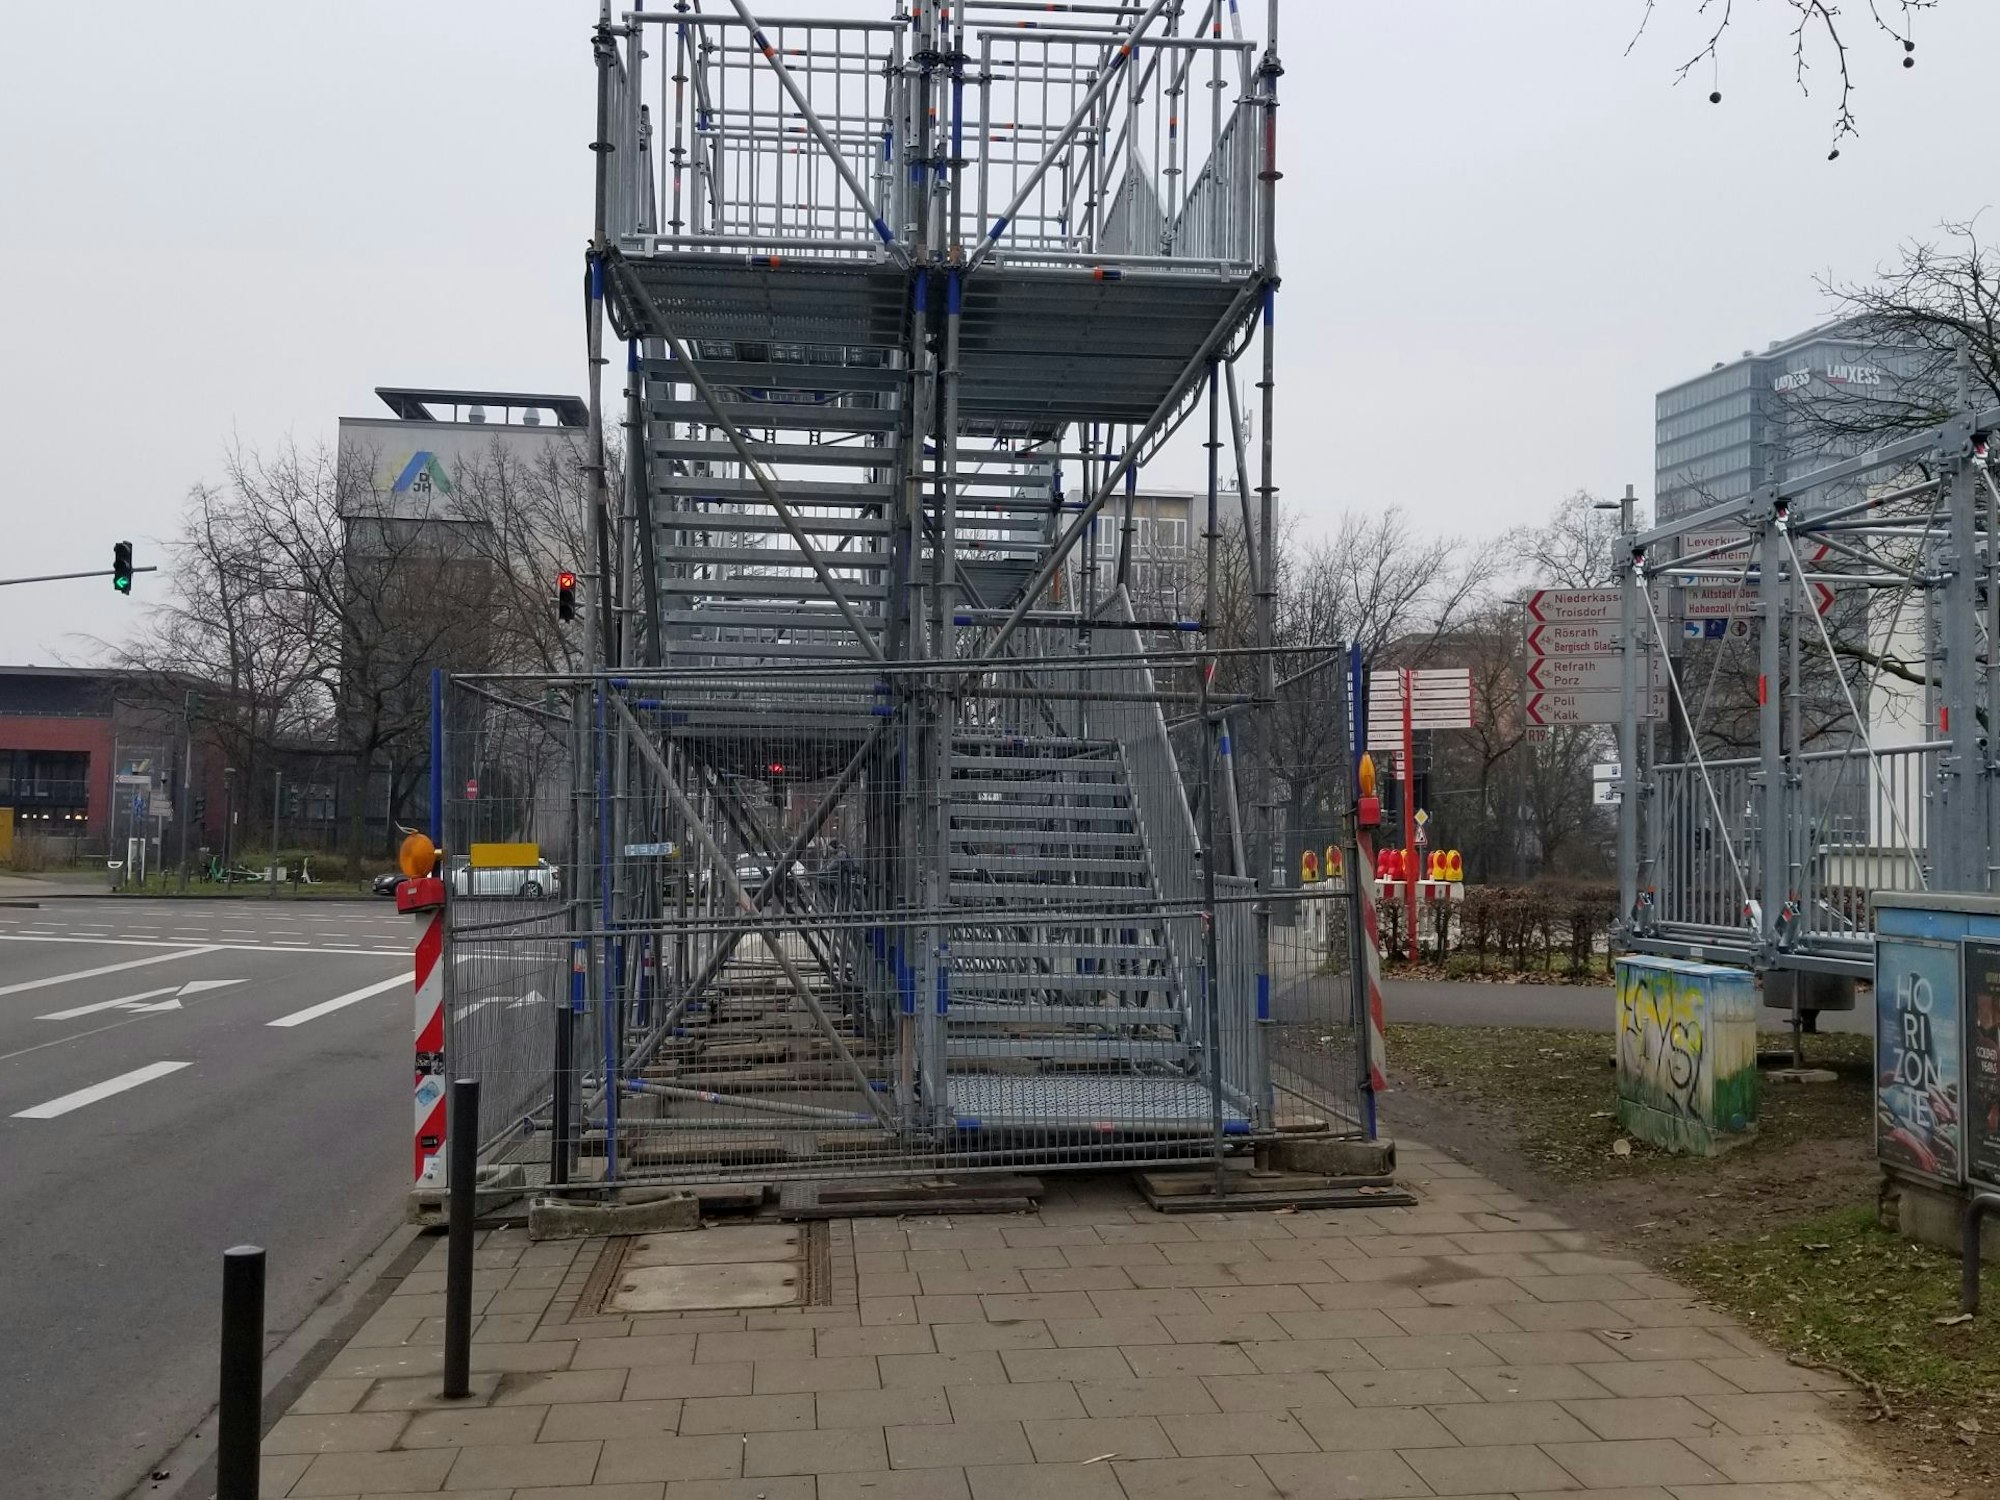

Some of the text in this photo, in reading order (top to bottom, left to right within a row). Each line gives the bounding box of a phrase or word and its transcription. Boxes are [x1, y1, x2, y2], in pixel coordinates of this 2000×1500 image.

[1827, 364, 1881, 385] LANXESS
[1554, 592, 1622, 604] Niederkass
[1556, 606, 1607, 617] Troisdorf
[1554, 627, 1598, 638] Rösrath
[1554, 642, 1590, 653] Bergisch
[1554, 661, 1596, 672] Refrath
[1554, 675, 1580, 686] Porz
[1553, 696, 1575, 706] Poll
[1553, 710, 1579, 720] Kalk
[1528, 729, 1546, 742] R19
